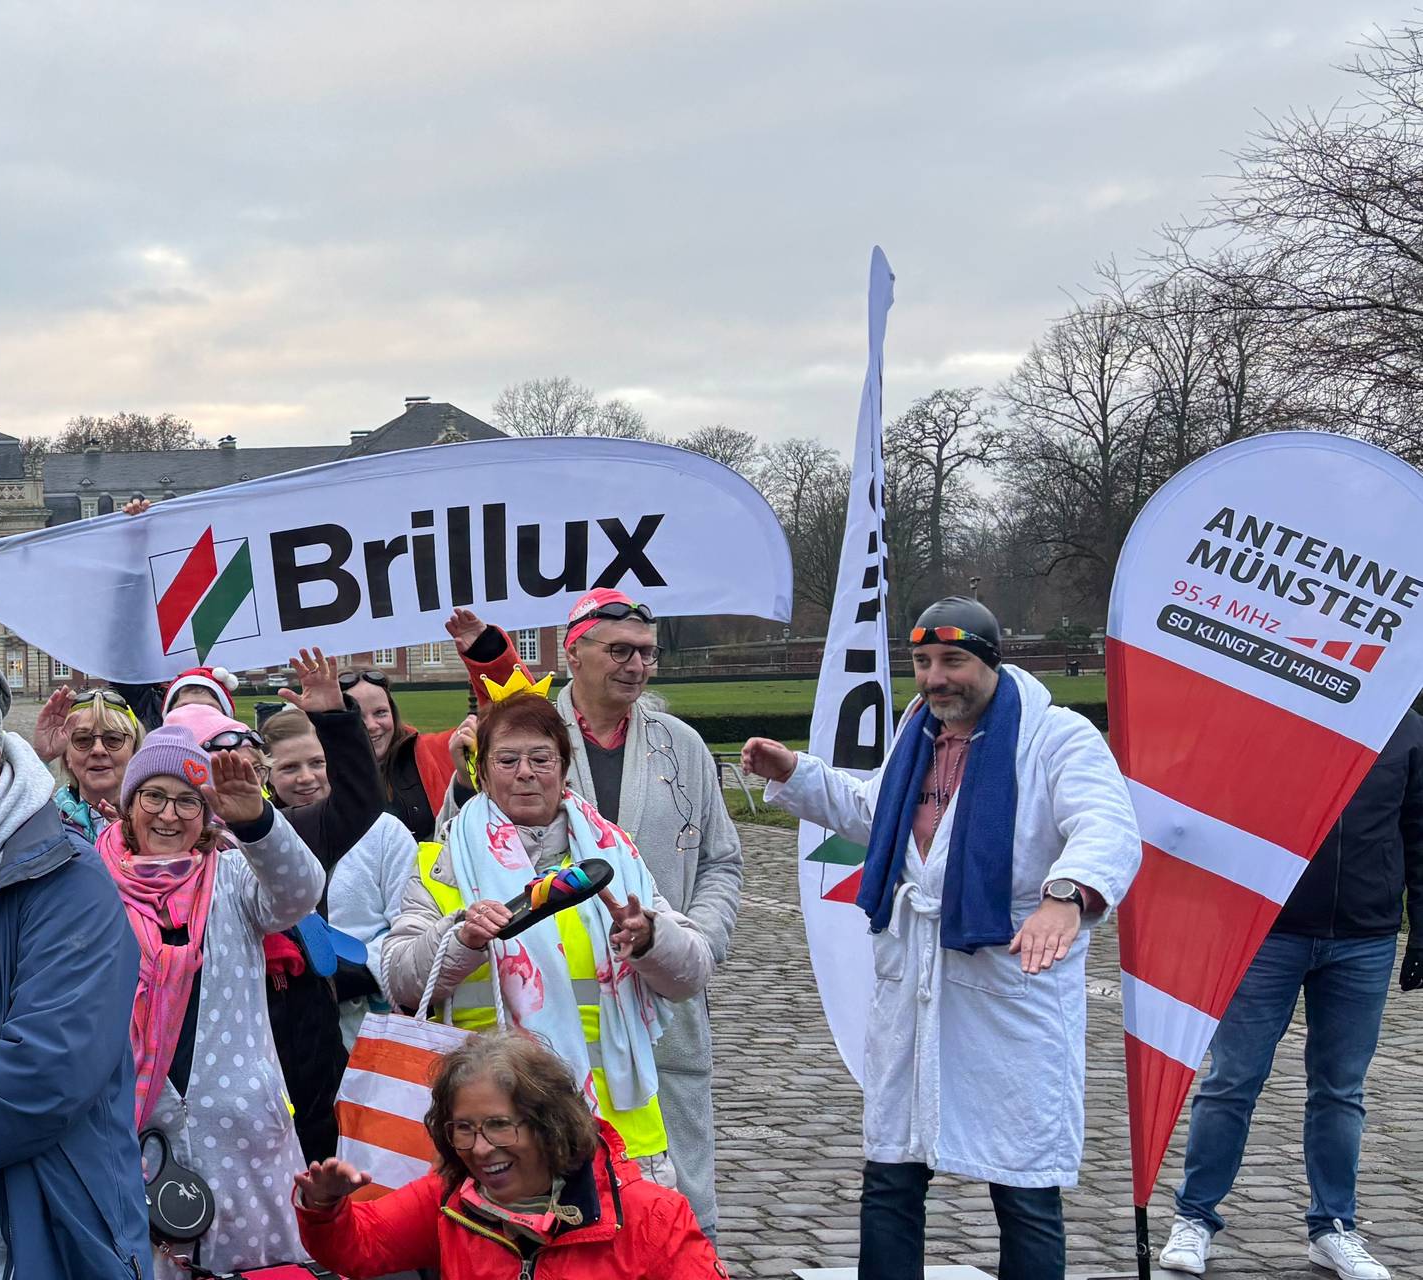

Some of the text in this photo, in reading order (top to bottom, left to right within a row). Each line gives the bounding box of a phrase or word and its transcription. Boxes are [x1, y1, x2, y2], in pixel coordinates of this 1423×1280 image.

[269, 501, 668, 632] Brillux
[1171, 579, 1283, 634] 95.4 MHz
[1186, 538, 1403, 643] MÜNSTER
[1203, 506, 1423, 609] ANTENNE
[1166, 611, 1353, 697] SO KLINGT ZU HAUSE
